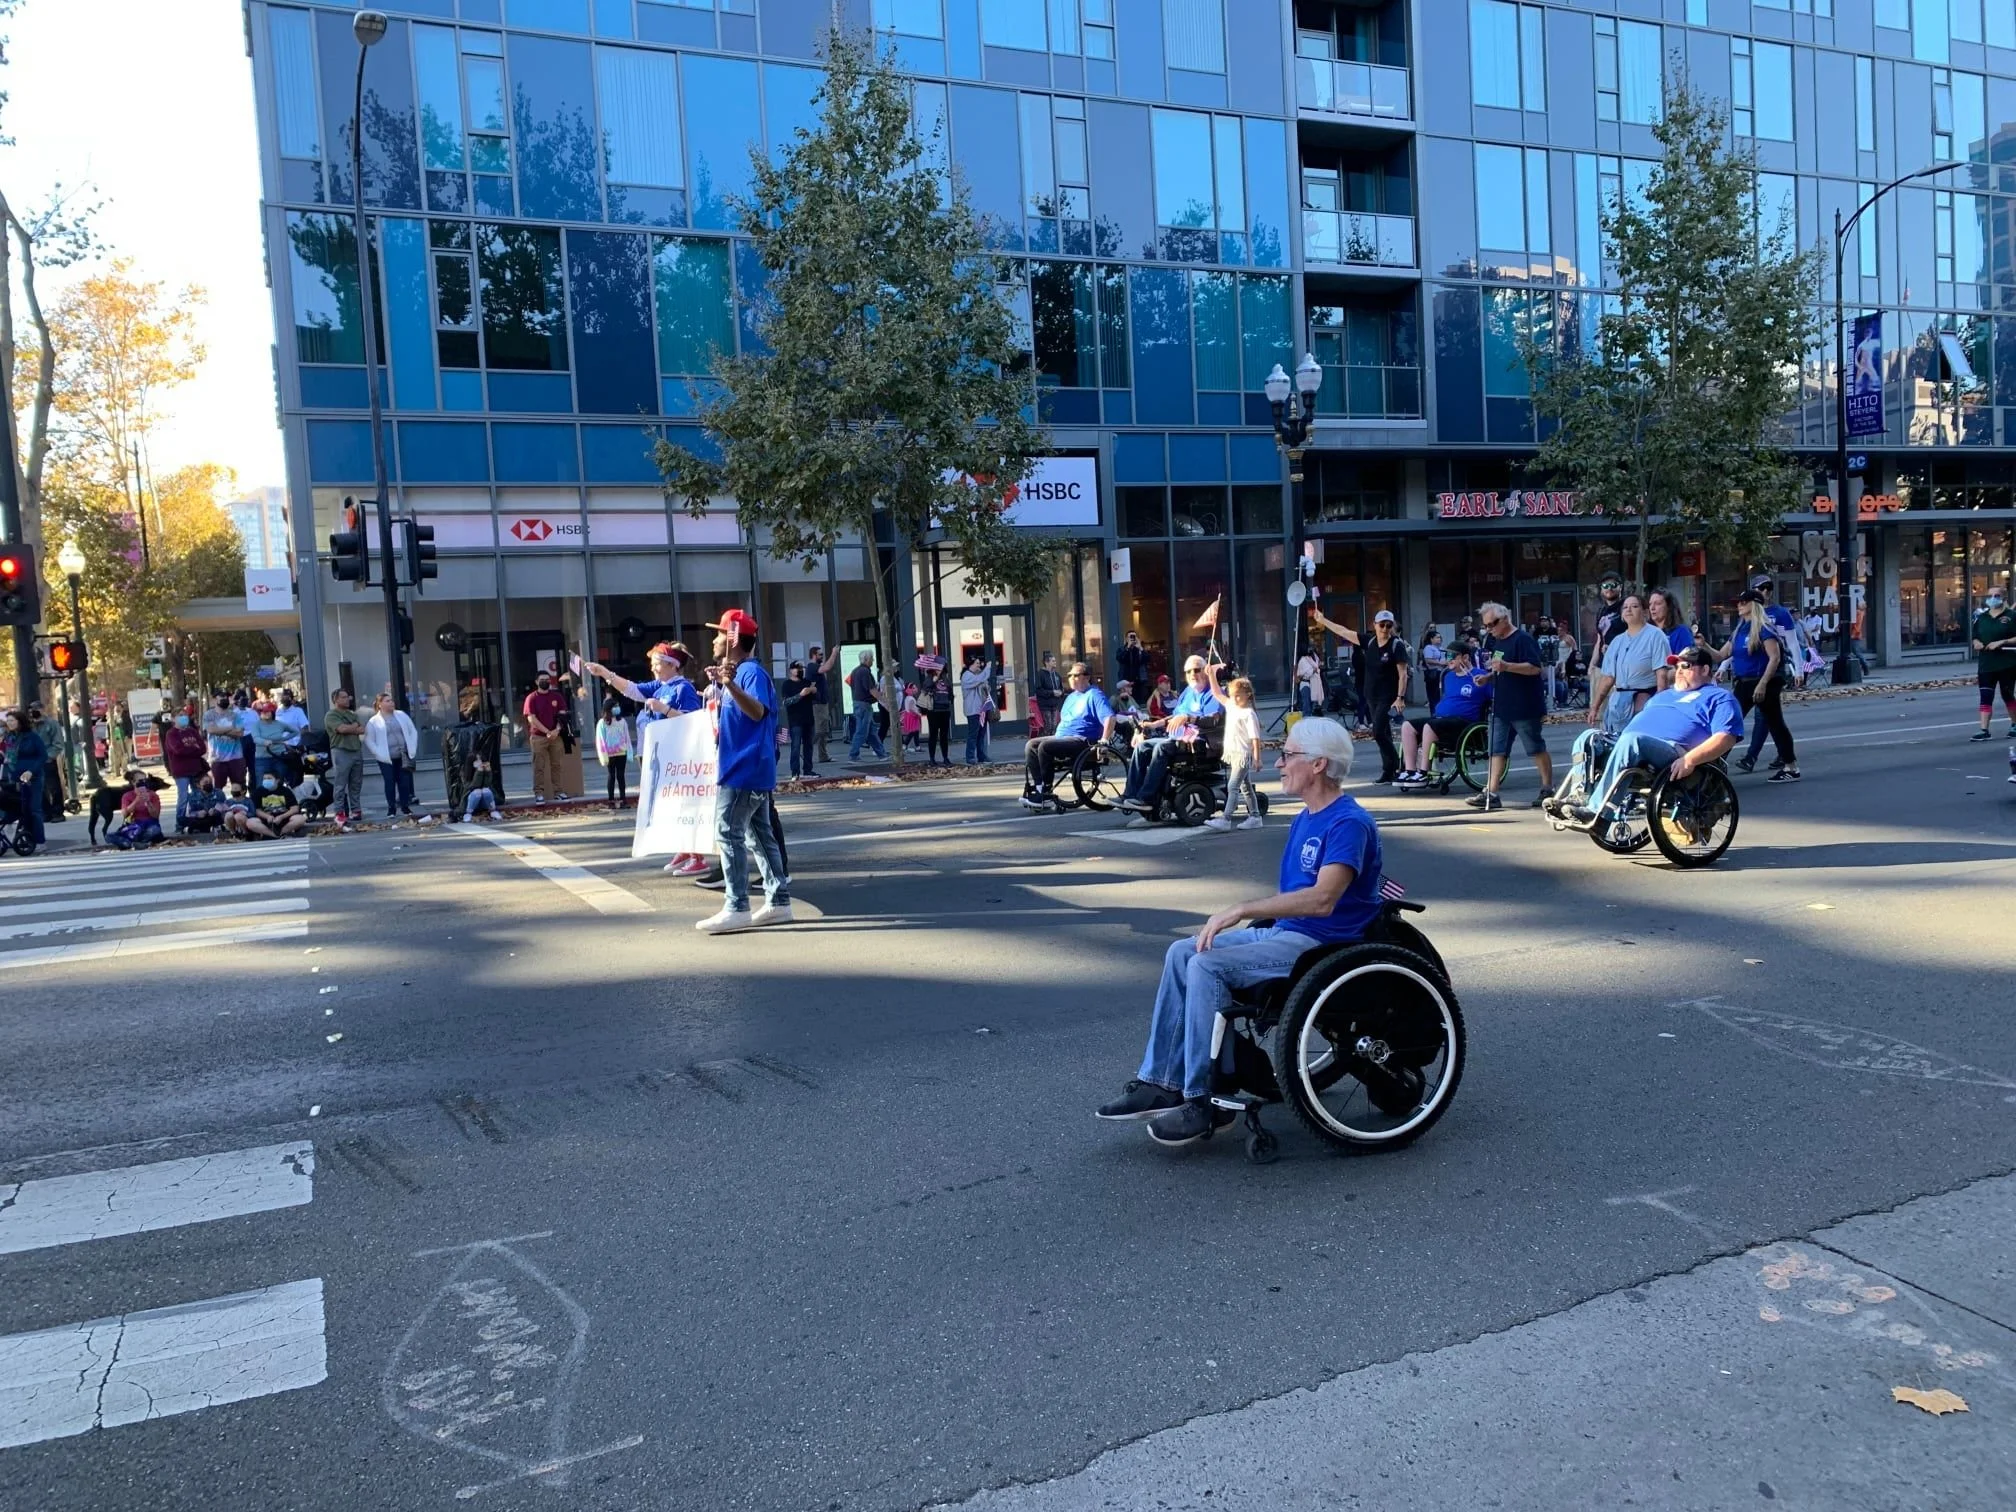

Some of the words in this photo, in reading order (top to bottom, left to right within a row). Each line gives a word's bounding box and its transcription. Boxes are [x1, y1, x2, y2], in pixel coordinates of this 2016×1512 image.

[1848, 394, 1878, 410] HITO
[1848, 456, 1866, 469] 2C
[1025, 482, 1081, 500] HSBC
[1439, 491, 1505, 518] EARL
[1506, 489, 1522, 518] of
[1802, 556, 1873, 579] YOR
[1803, 584, 1866, 608] HAR
[662, 781, 672, 798] of
